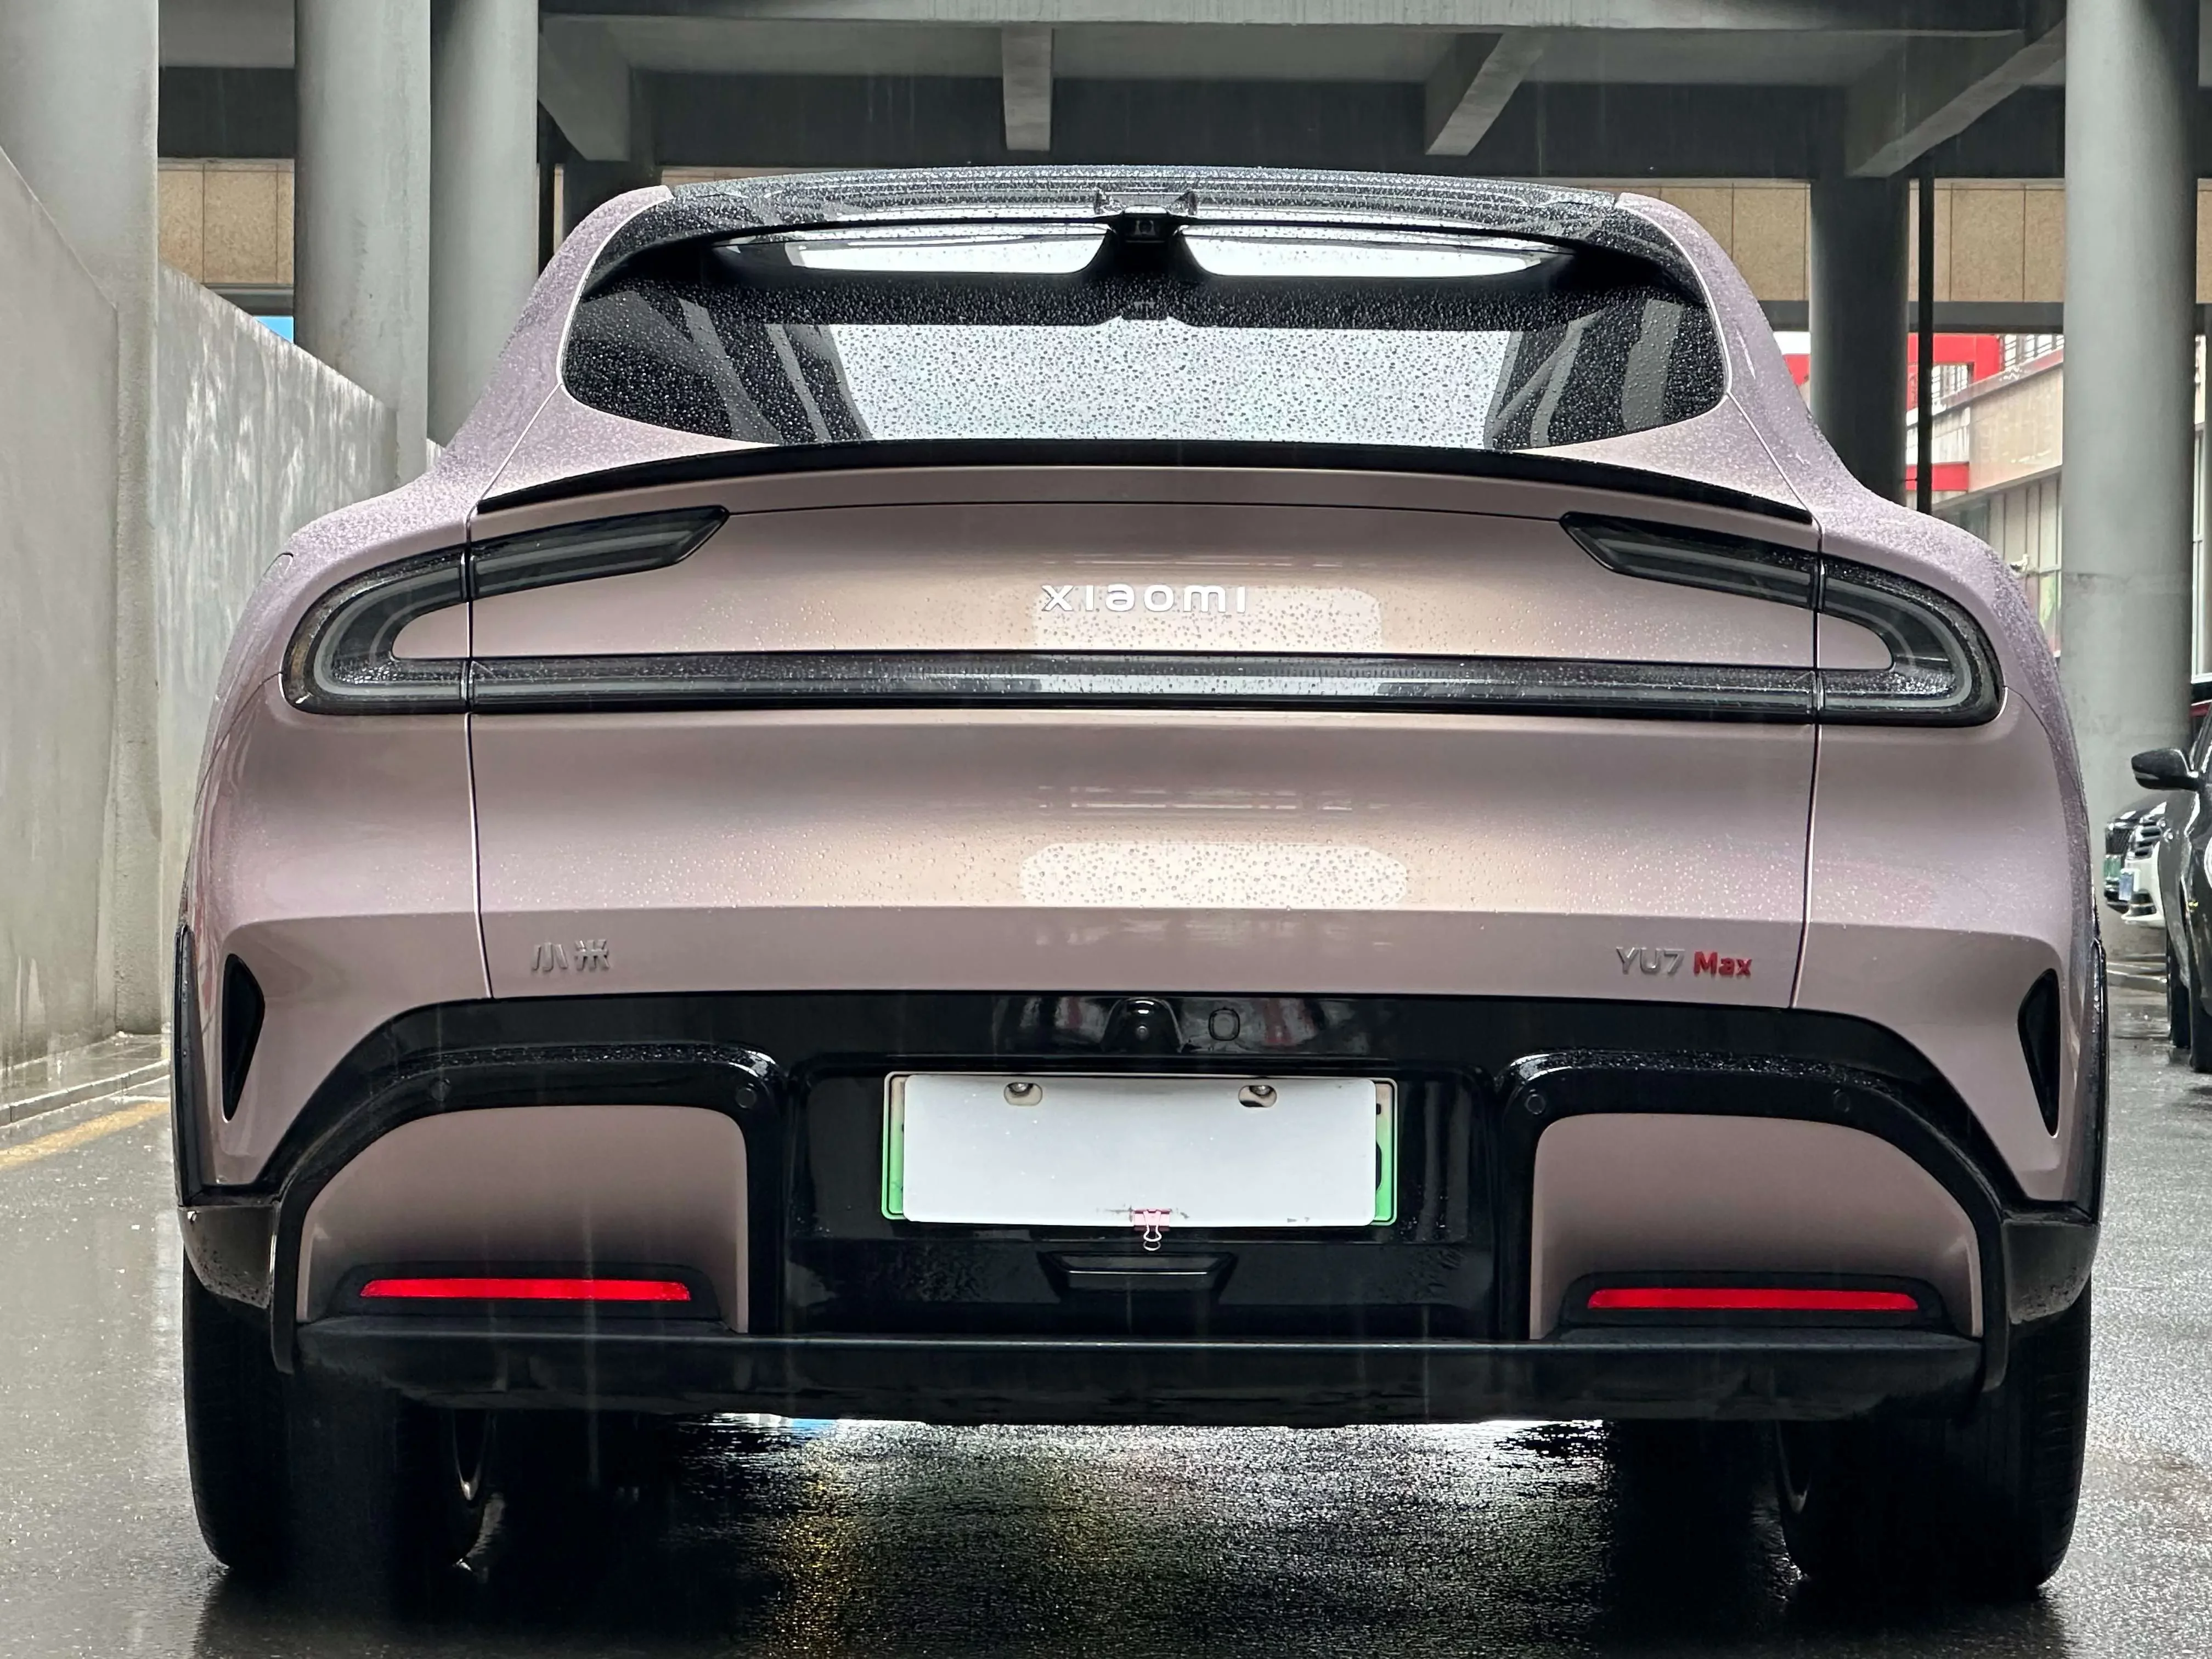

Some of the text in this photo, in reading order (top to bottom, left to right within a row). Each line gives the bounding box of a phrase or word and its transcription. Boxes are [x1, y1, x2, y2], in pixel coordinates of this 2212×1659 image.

[1042, 584, 1245, 613] xiaomi
[531, 939, 610, 972] 小米
[1616, 947, 1753, 977] YU7 Max
